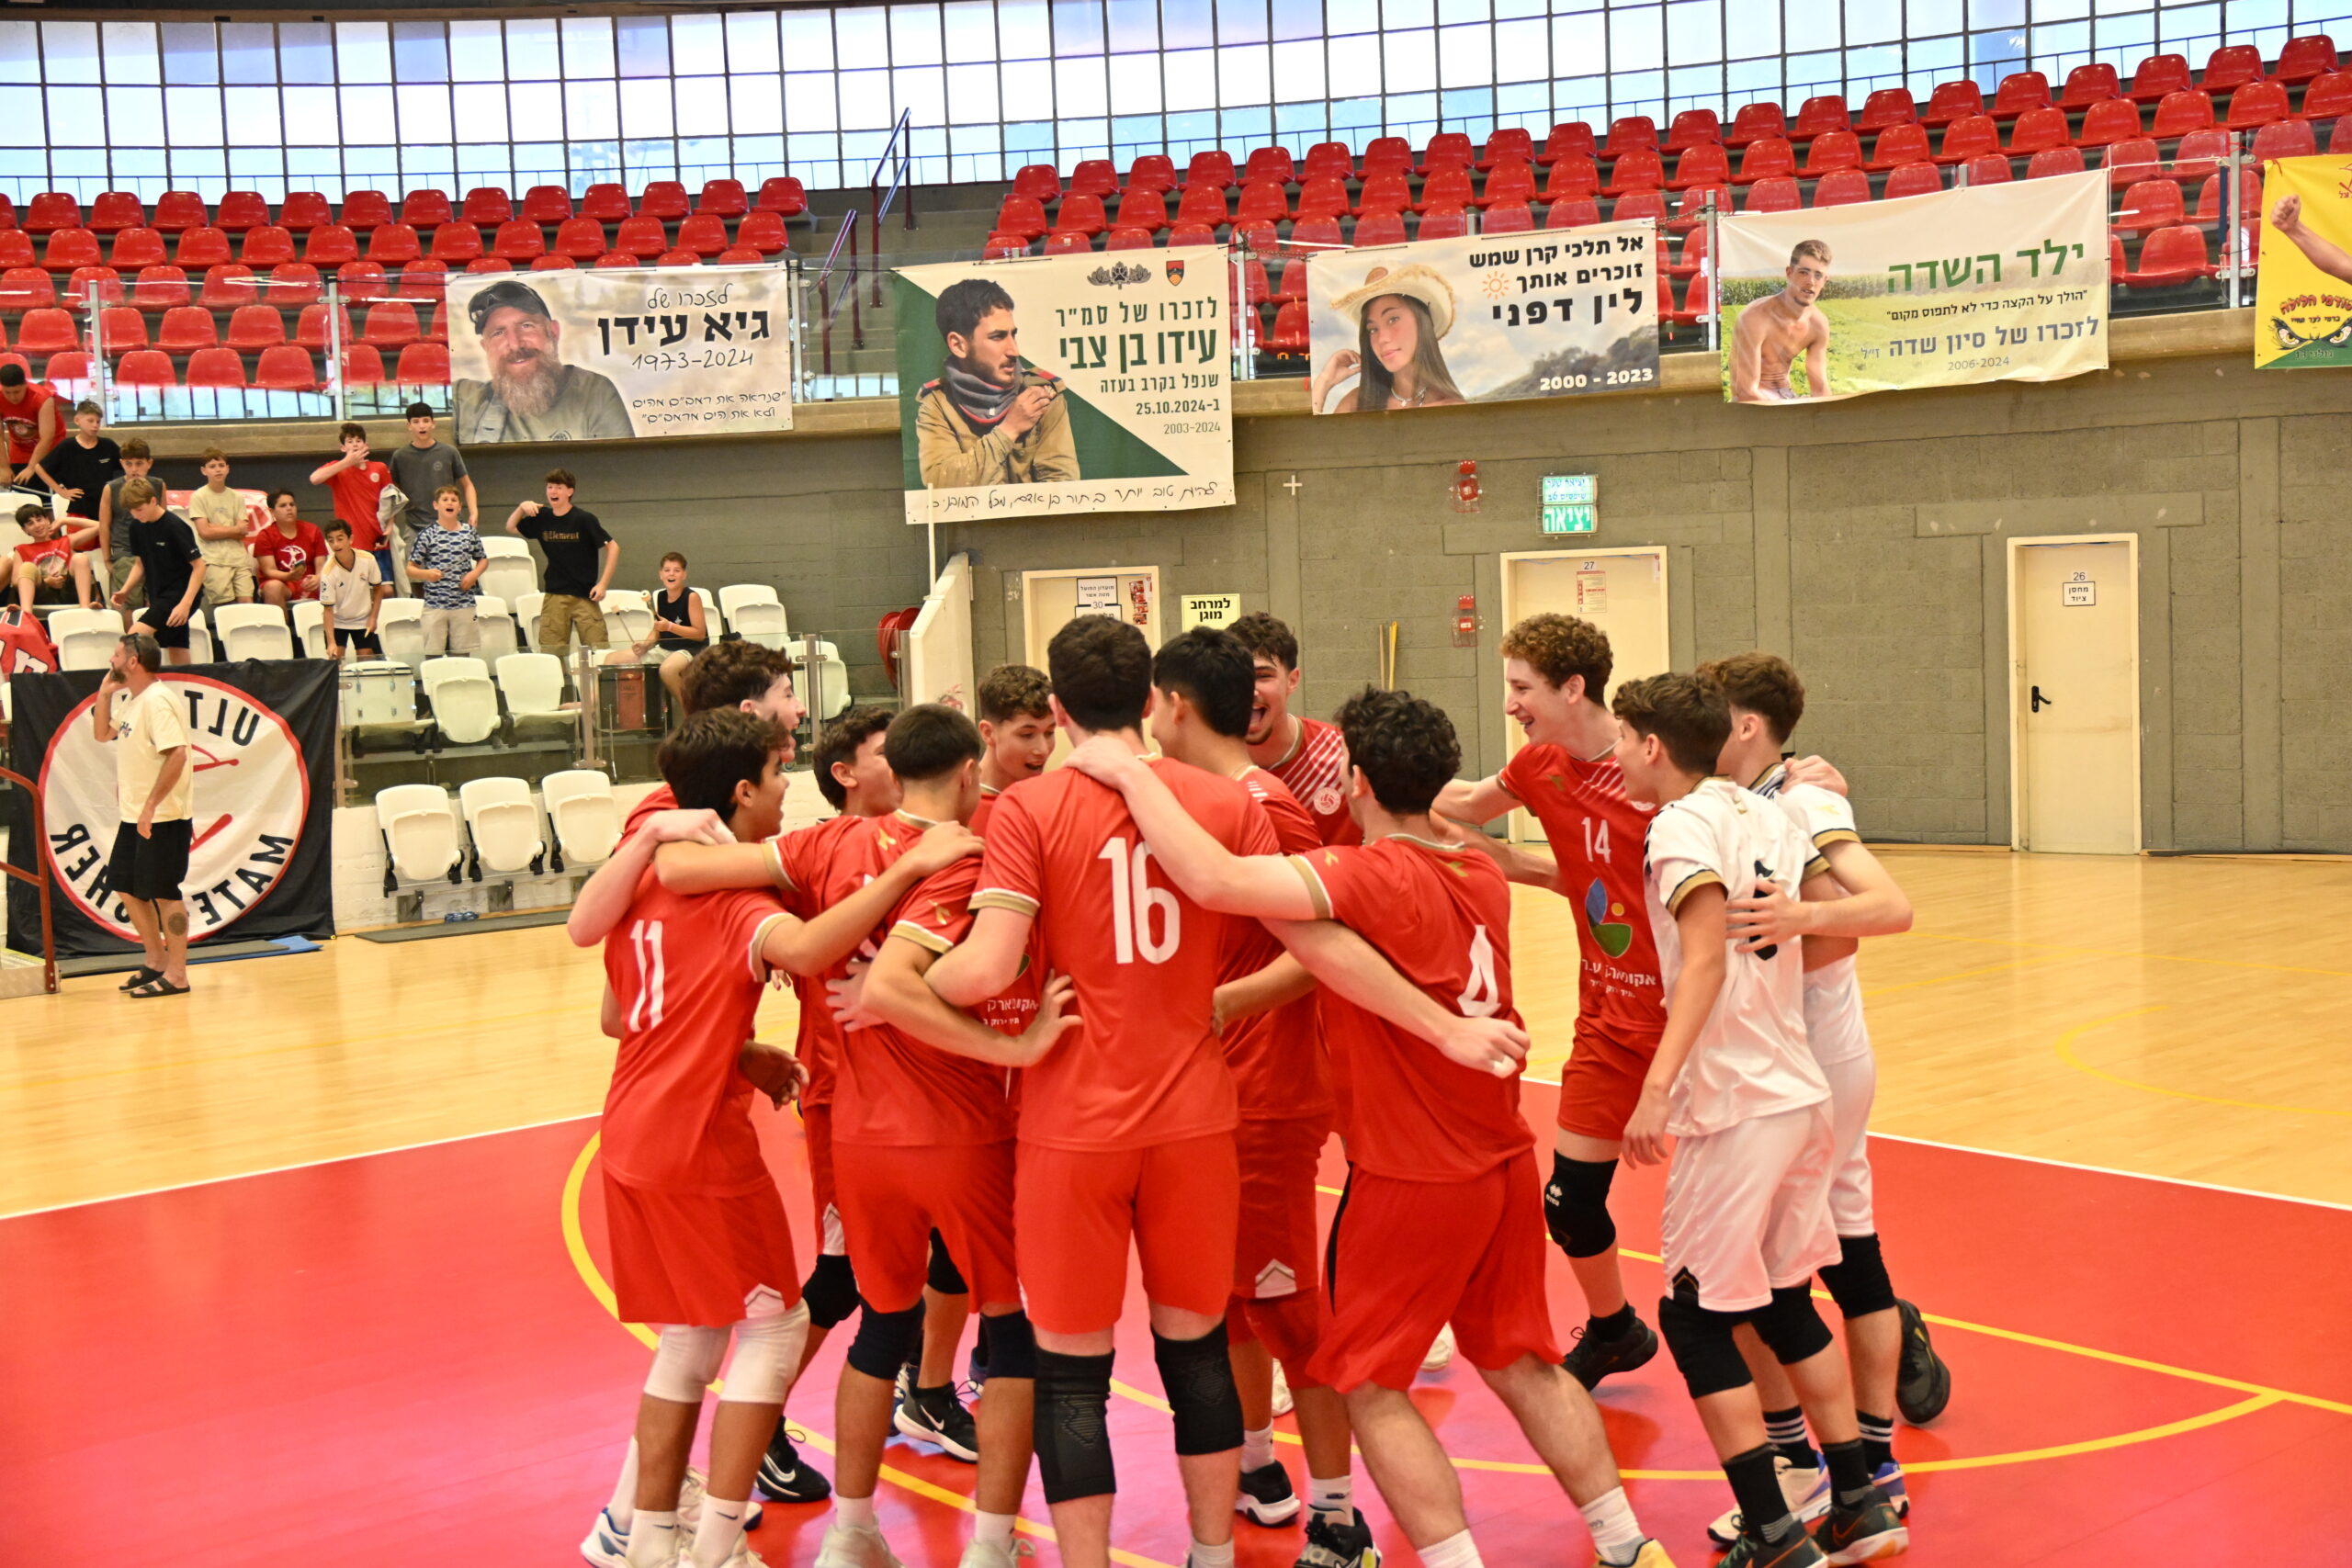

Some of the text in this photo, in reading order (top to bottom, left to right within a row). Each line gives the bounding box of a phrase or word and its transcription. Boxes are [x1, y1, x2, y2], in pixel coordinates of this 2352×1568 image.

[1469, 235, 1644, 268] אל תלכי קרן שמש
[1888, 238, 2084, 293] ילד השדה
[1517, 264, 1644, 294] זוכרים אותך
[648, 283, 734, 309] לזכרו של
[1981, 300, 1999, 310] כדי
[2002, 297, 2034, 310] הקצה
[2037, 294, 2052, 305] על
[1120, 301, 1148, 323] של
[1159, 297, 1217, 321] לזכרו
[1493, 288, 1643, 327] לין דפני
[1923, 304, 1958, 317] לתפוס
[1962, 302, 1976, 314] לא
[597, 310, 770, 355] גיא עידן
[1995, 325, 2028, 346] של
[2037, 315, 2099, 342] לזכרו
[1060, 329, 1216, 373] עידו בן צבי
[1889, 336, 1937, 356] שדה
[1946, 332, 1985, 355] סיון
[632, 348, 753, 371] 1973-2024
[1948, 356, 2010, 371] 2006-2024
[1101, 373, 1219, 393] שנפל בקרב בעזה
[1539, 374, 1588, 391] 2000
[1607, 367, 1653, 385] 2023
[717, 395, 735, 405] את
[703, 411, 727, 423] הים
[731, 410, 750, 419] את
[1164, 422, 1221, 434] 2003-2024
[1544, 507, 1590, 532] יציאה
[1584, 561, 1595, 570] 27
[2073, 571, 2086, 581] 26
[2068, 586, 2088, 594] מחסן
[1092, 601, 1102, 609] 30
[1190, 598, 1231, 610] למרחב
[1199, 611, 1223, 622] מוגן
[1581, 817, 1611, 864] 14
[1098, 837, 1181, 964] 16
[629, 919, 663, 1033] 11
